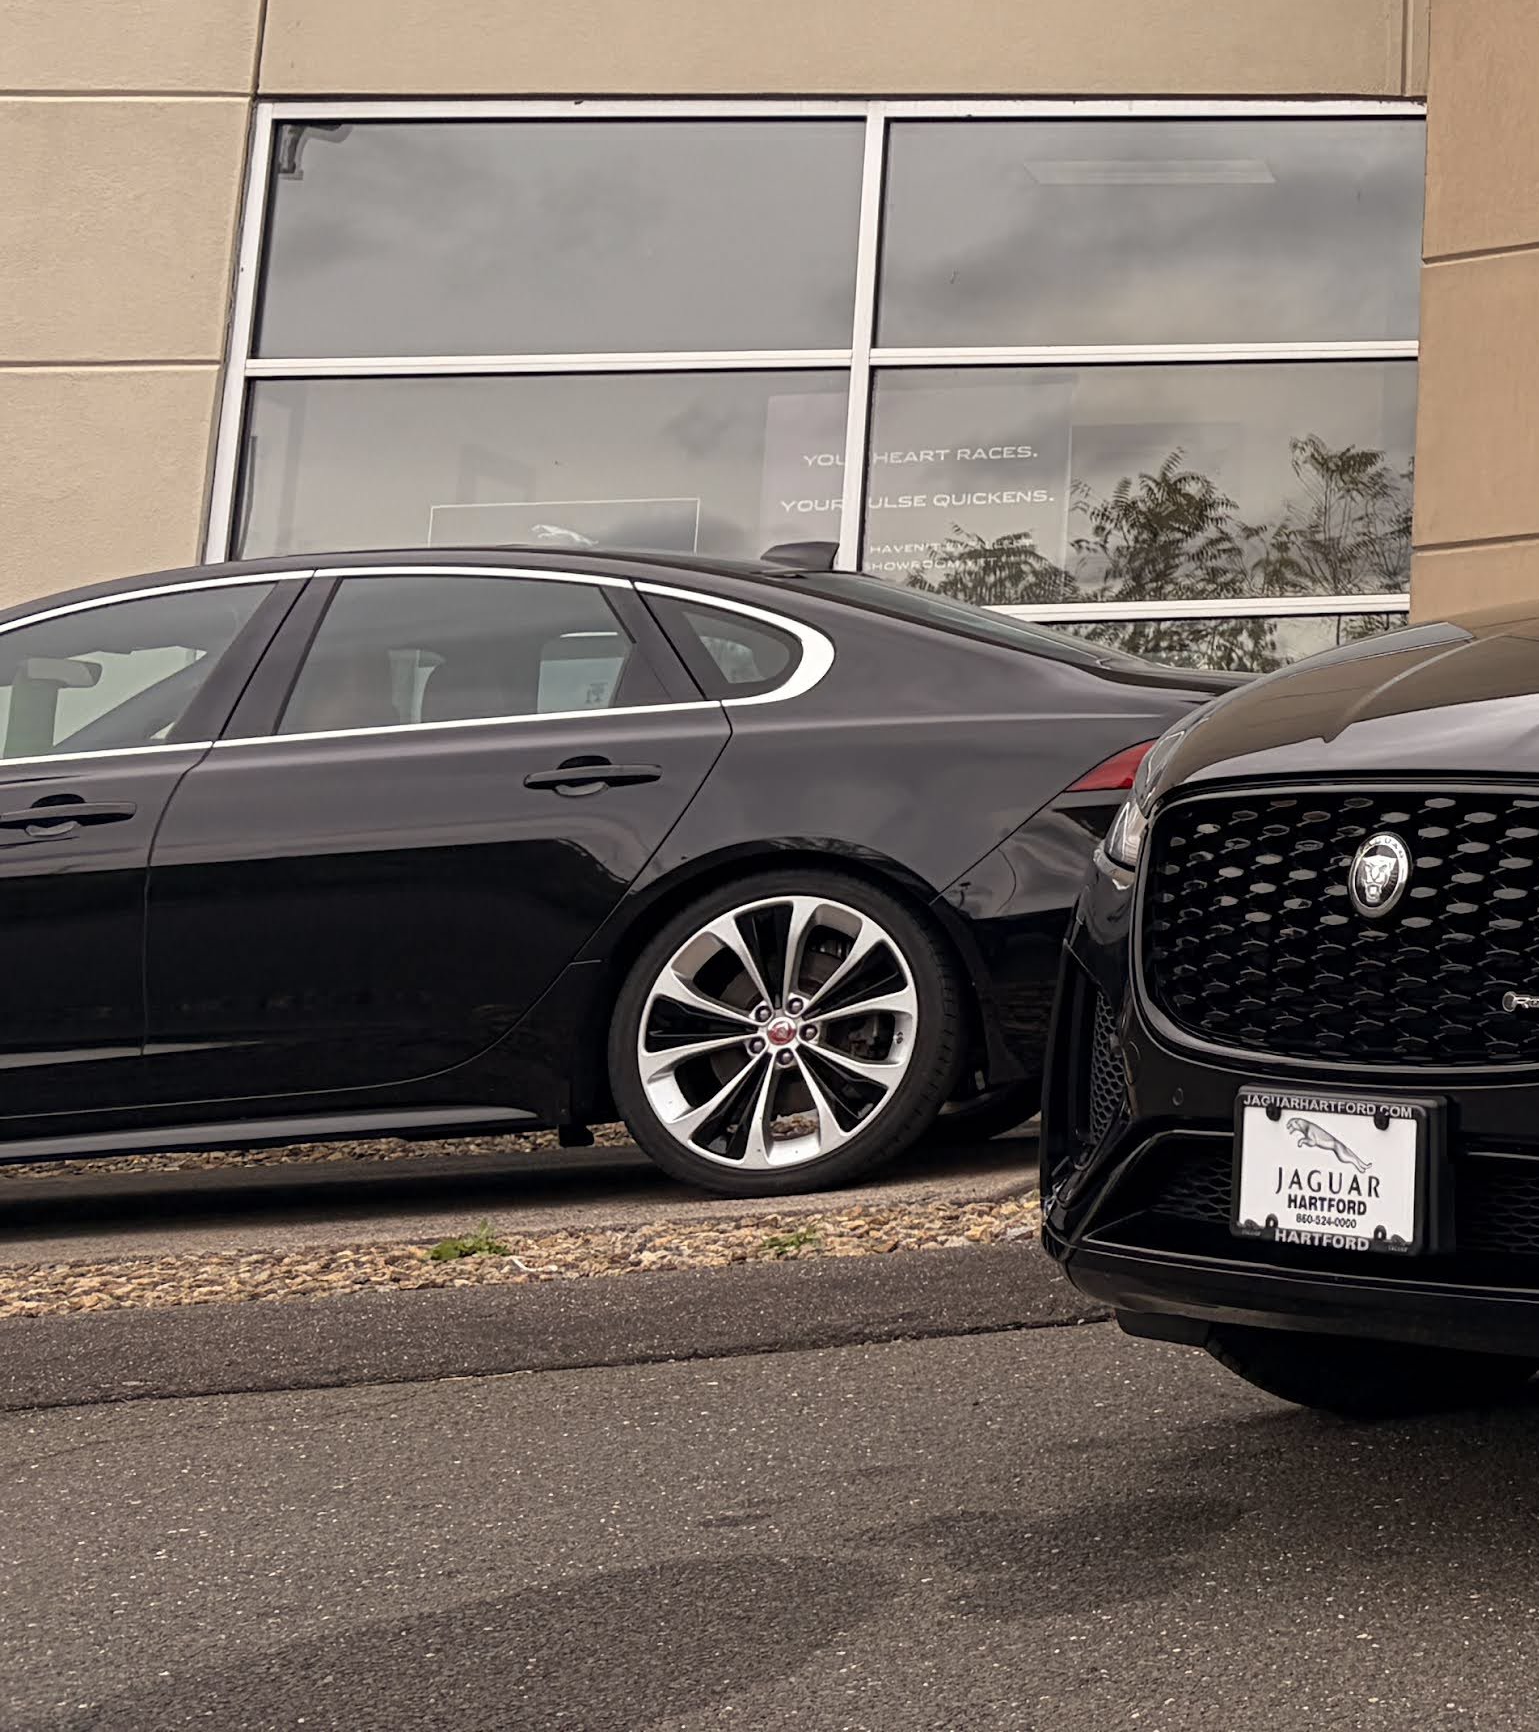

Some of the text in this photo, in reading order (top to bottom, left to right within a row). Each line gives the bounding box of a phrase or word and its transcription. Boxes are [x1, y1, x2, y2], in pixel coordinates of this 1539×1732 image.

[803, 445, 1038, 467] YOU HEART RACES.
[867, 494, 927, 509] ULSE
[932, 488, 1054, 508] QUICKENS.
[1243, 1094, 1412, 1118] JAGUARHARTFORDCOM
[1275, 1166, 1381, 1198] JAGUAR
[1287, 1193, 1367, 1216] HARTFORD
[1273, 1229, 1370, 1252] HARTFORD
